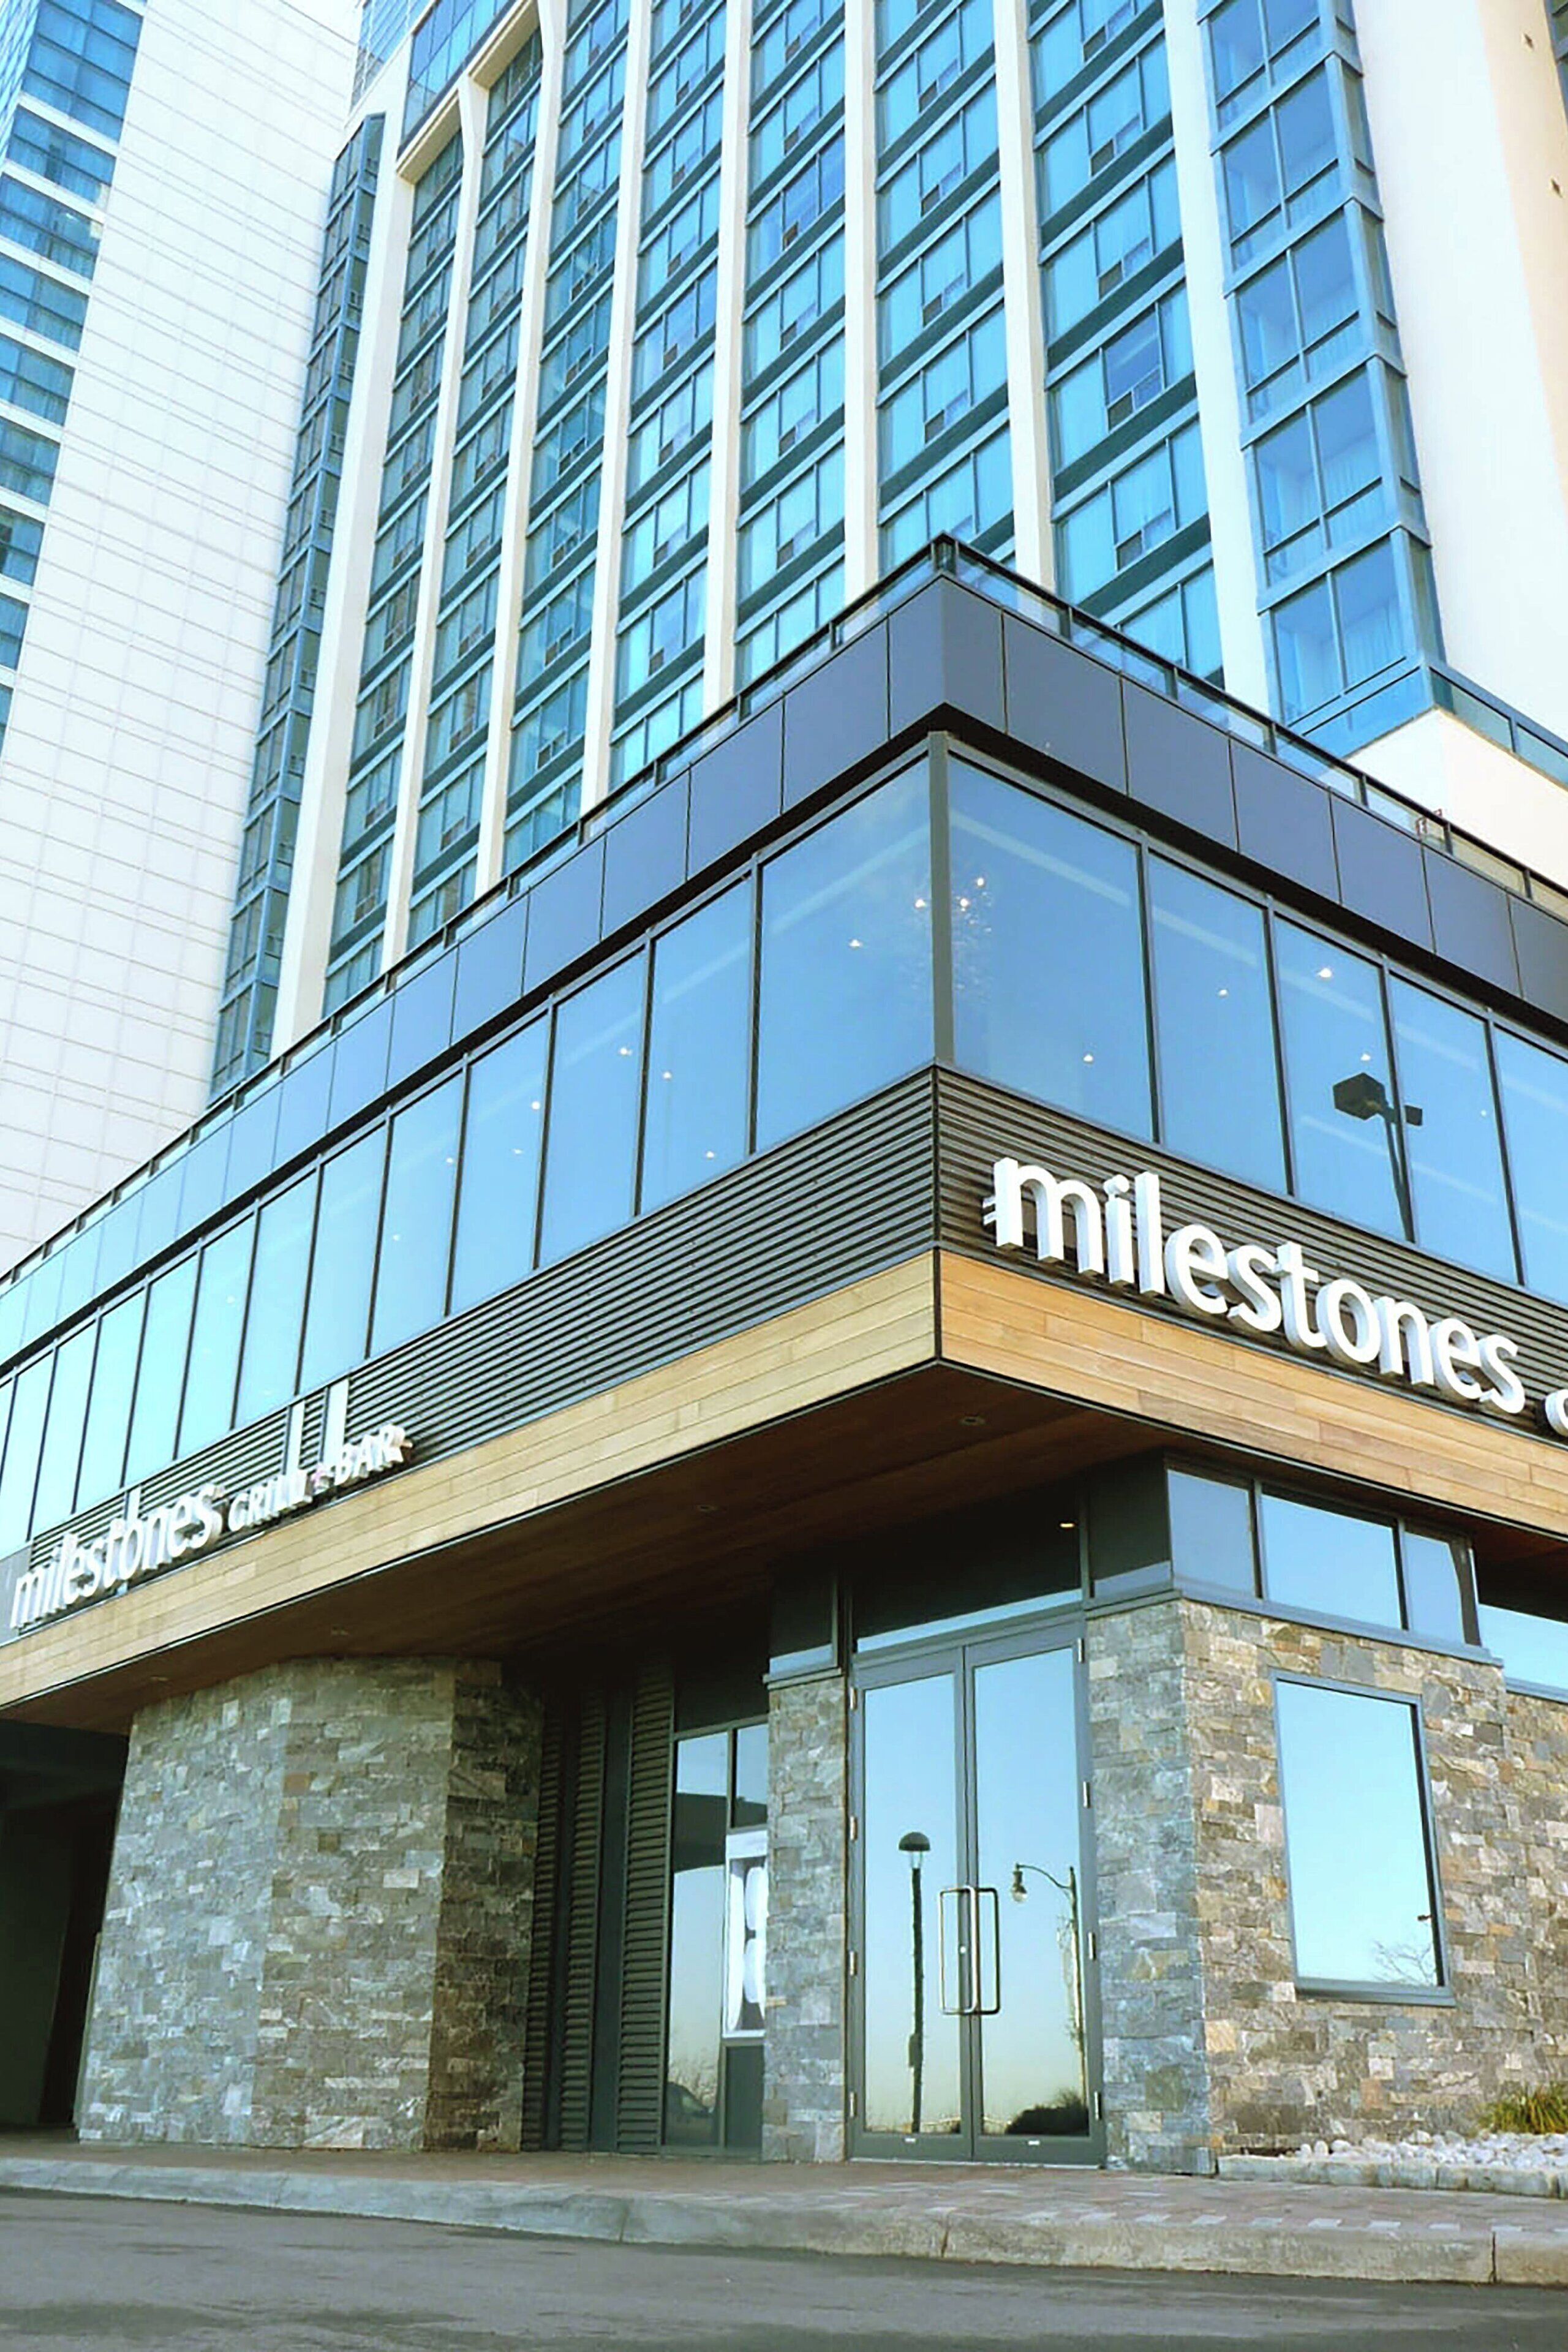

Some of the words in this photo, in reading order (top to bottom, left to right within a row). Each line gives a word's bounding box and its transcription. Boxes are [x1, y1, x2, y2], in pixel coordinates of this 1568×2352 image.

[985, 1158, 1525, 1414] milestones
[10, 1484, 223, 1628] milestones
[334, 1424, 412, 1486] BAR
